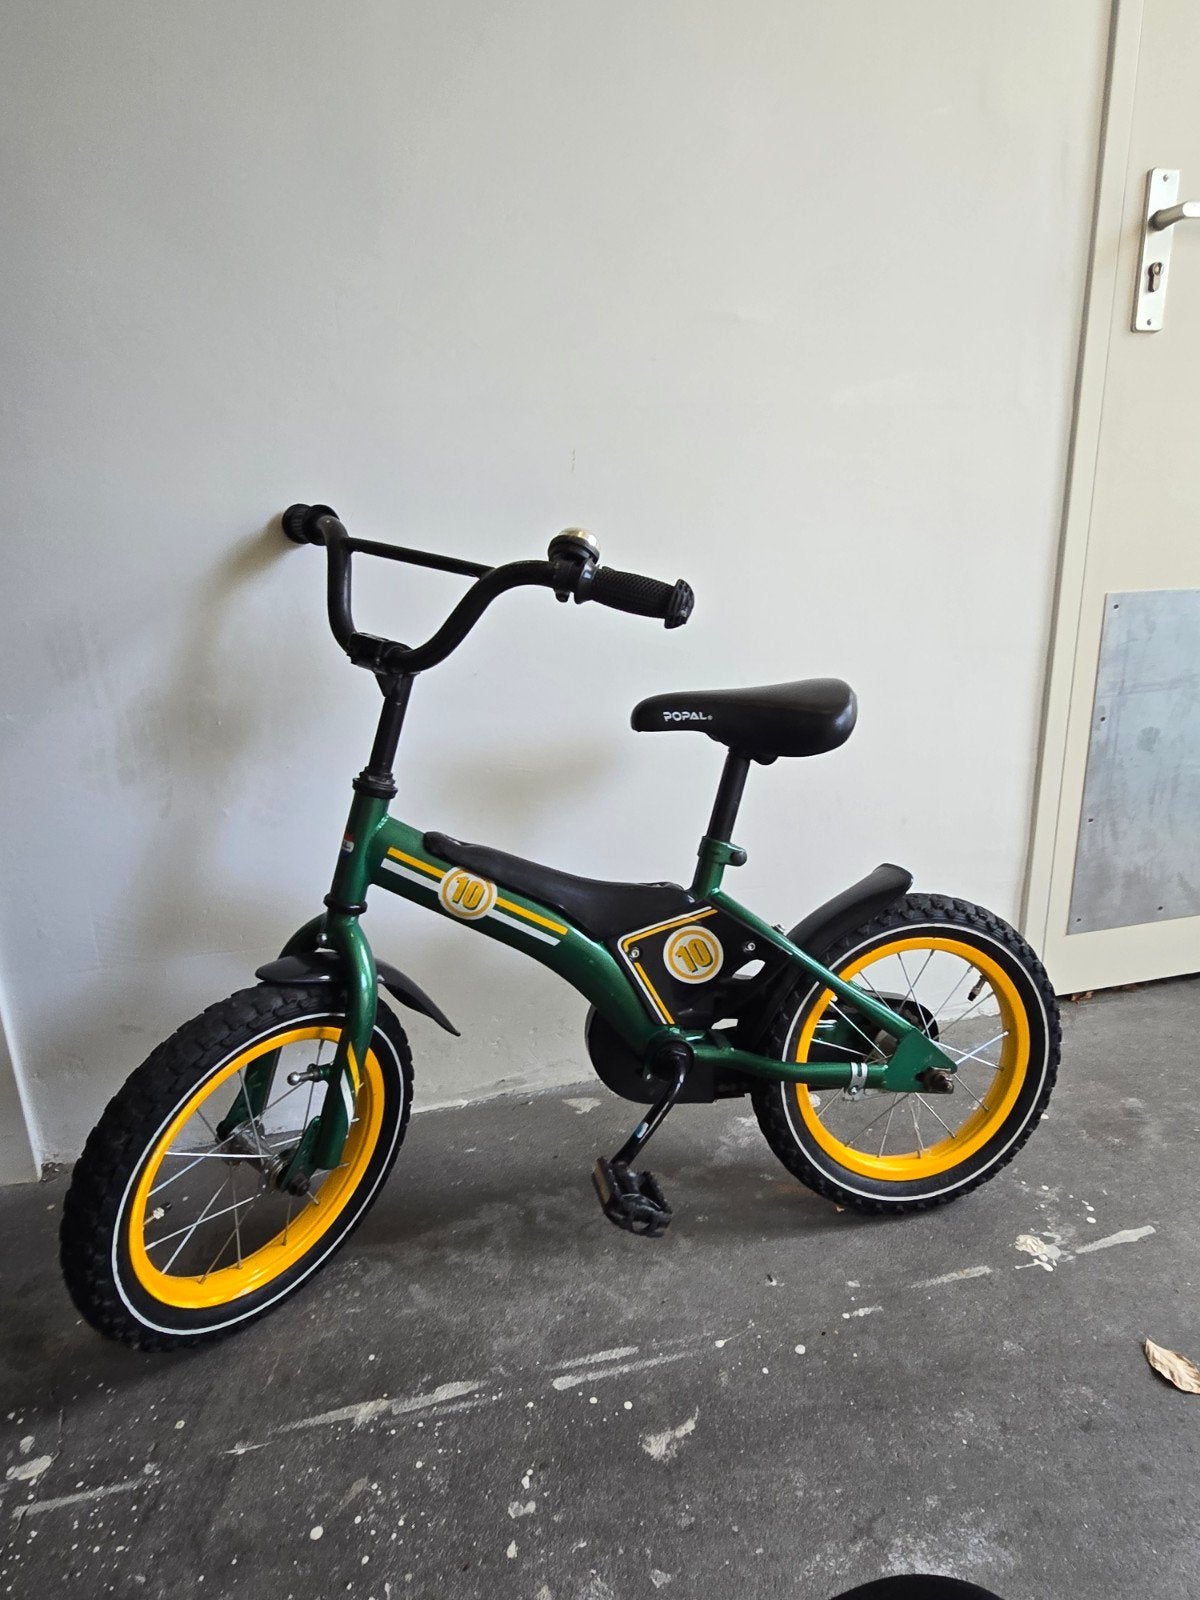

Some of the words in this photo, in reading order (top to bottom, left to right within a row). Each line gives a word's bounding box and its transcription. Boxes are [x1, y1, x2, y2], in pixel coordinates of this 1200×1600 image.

[663, 711, 707, 722] POPAL
[452, 875, 486, 910] 10
[675, 938, 714, 973] 10
